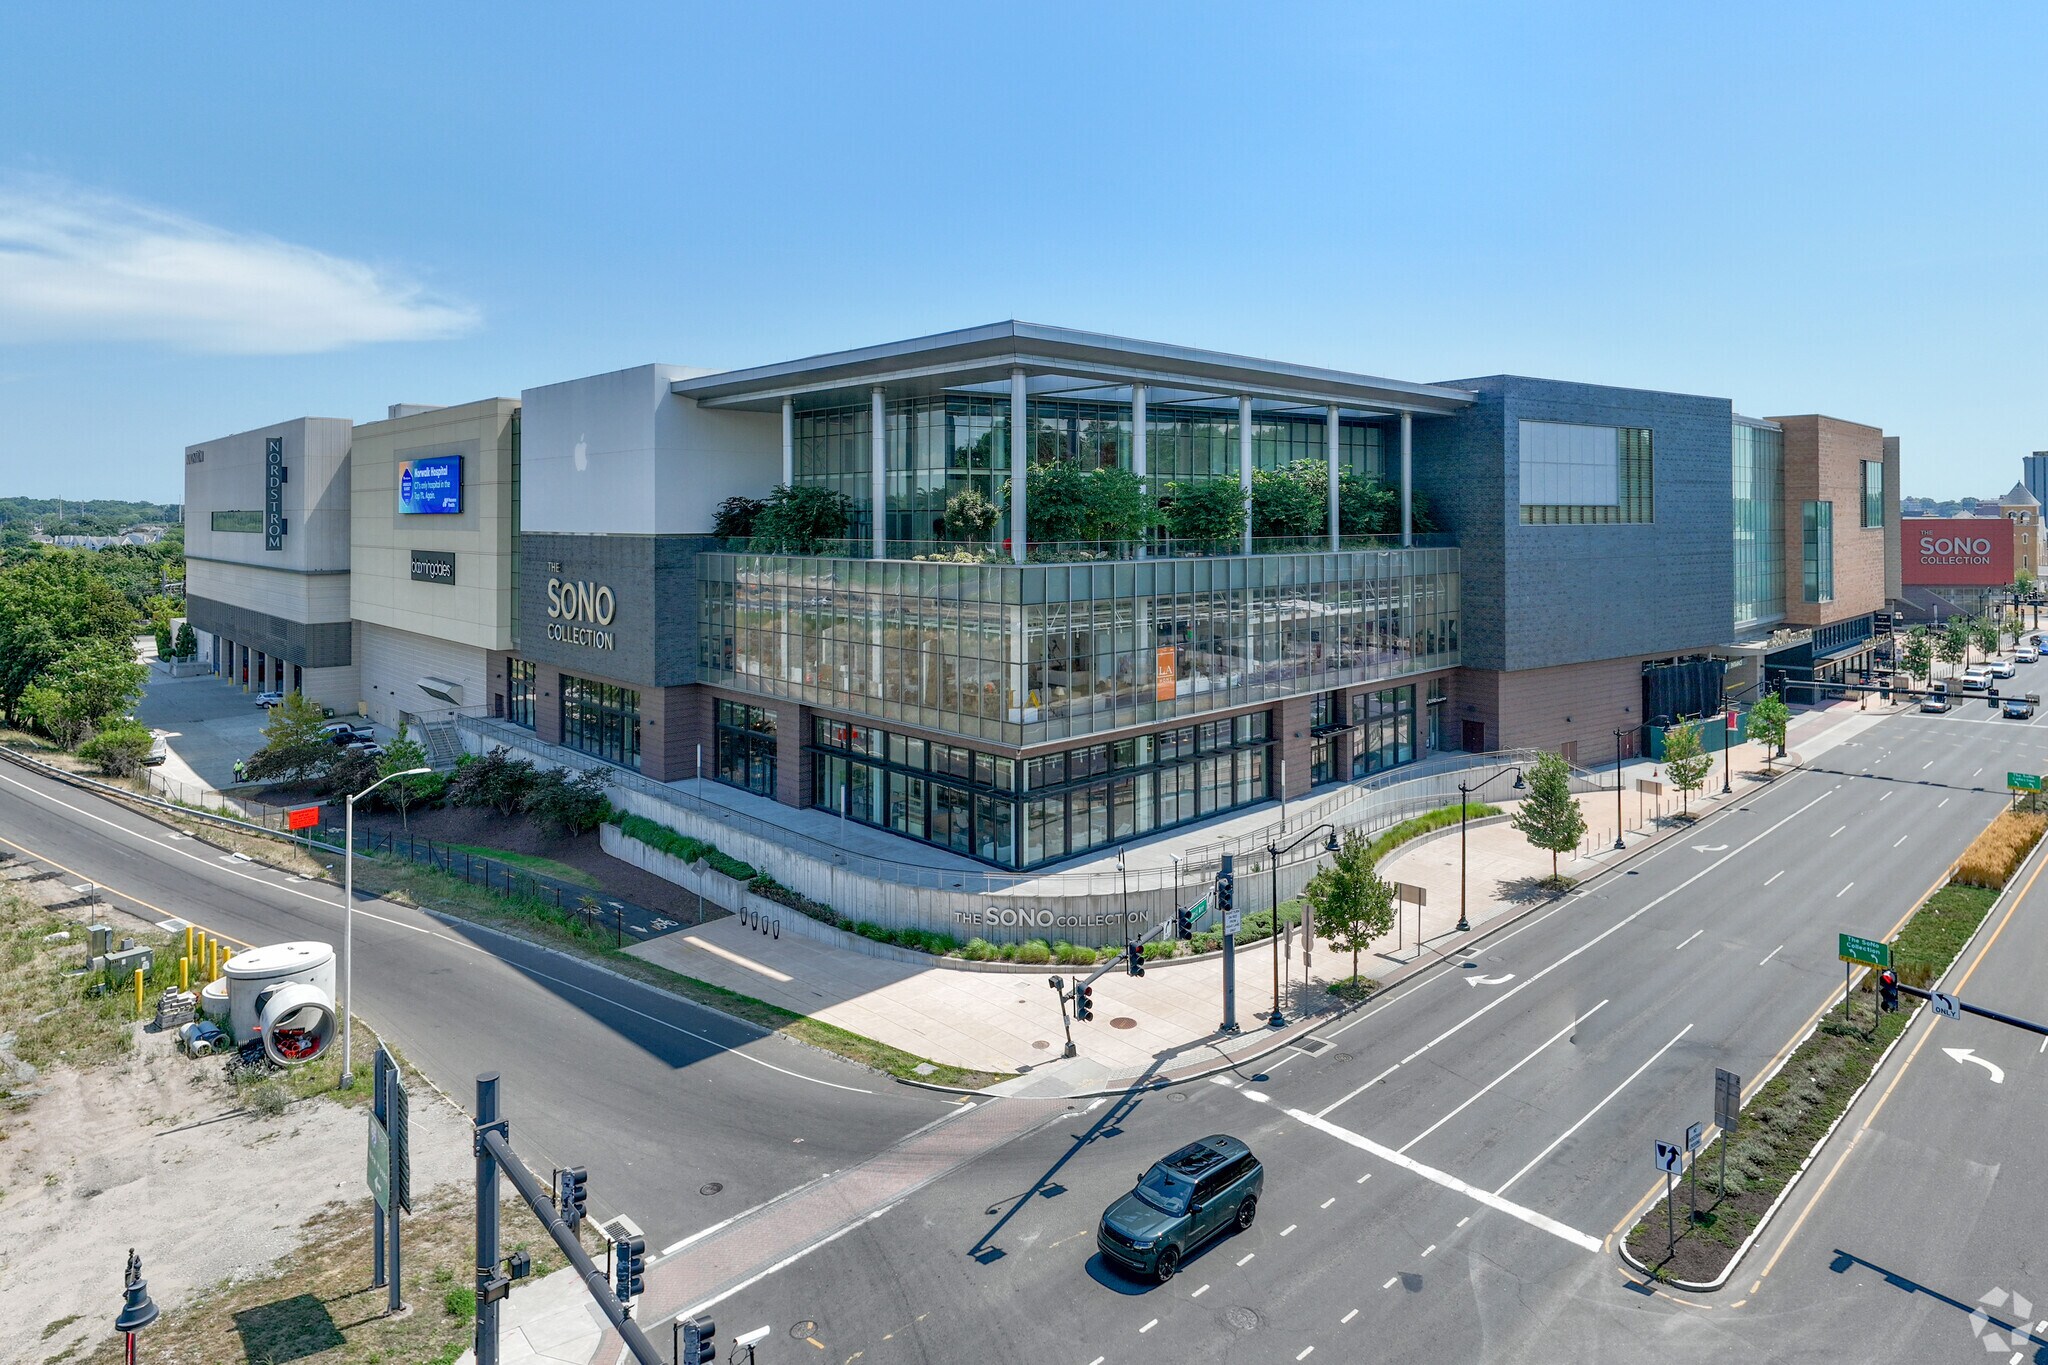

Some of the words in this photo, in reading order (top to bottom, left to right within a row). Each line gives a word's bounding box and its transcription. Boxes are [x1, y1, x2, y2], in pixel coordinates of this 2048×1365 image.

[414, 467, 430, 478] Norwalk
[430, 465, 448, 478] Hospital
[269, 441, 280, 547] NORDSTROM
[1920, 537, 1991, 555] SONO
[1920, 556, 1990, 565] COLLECTION
[547, 562, 561, 573] THE
[547, 578, 616, 626] SONO
[547, 623, 614, 651] COLLECTION
[1159, 665, 1173, 676] LA
[954, 912, 982, 925] THE
[986, 907, 1054, 927] SONO
[1056, 911, 1149, 928] COLLECTION
[1846, 942, 1881, 955] Collection
[1847, 936, 1860, 944] The
[1861, 940, 1880, 949] SoNo
[1935, 1006, 1957, 1018] ONLY
